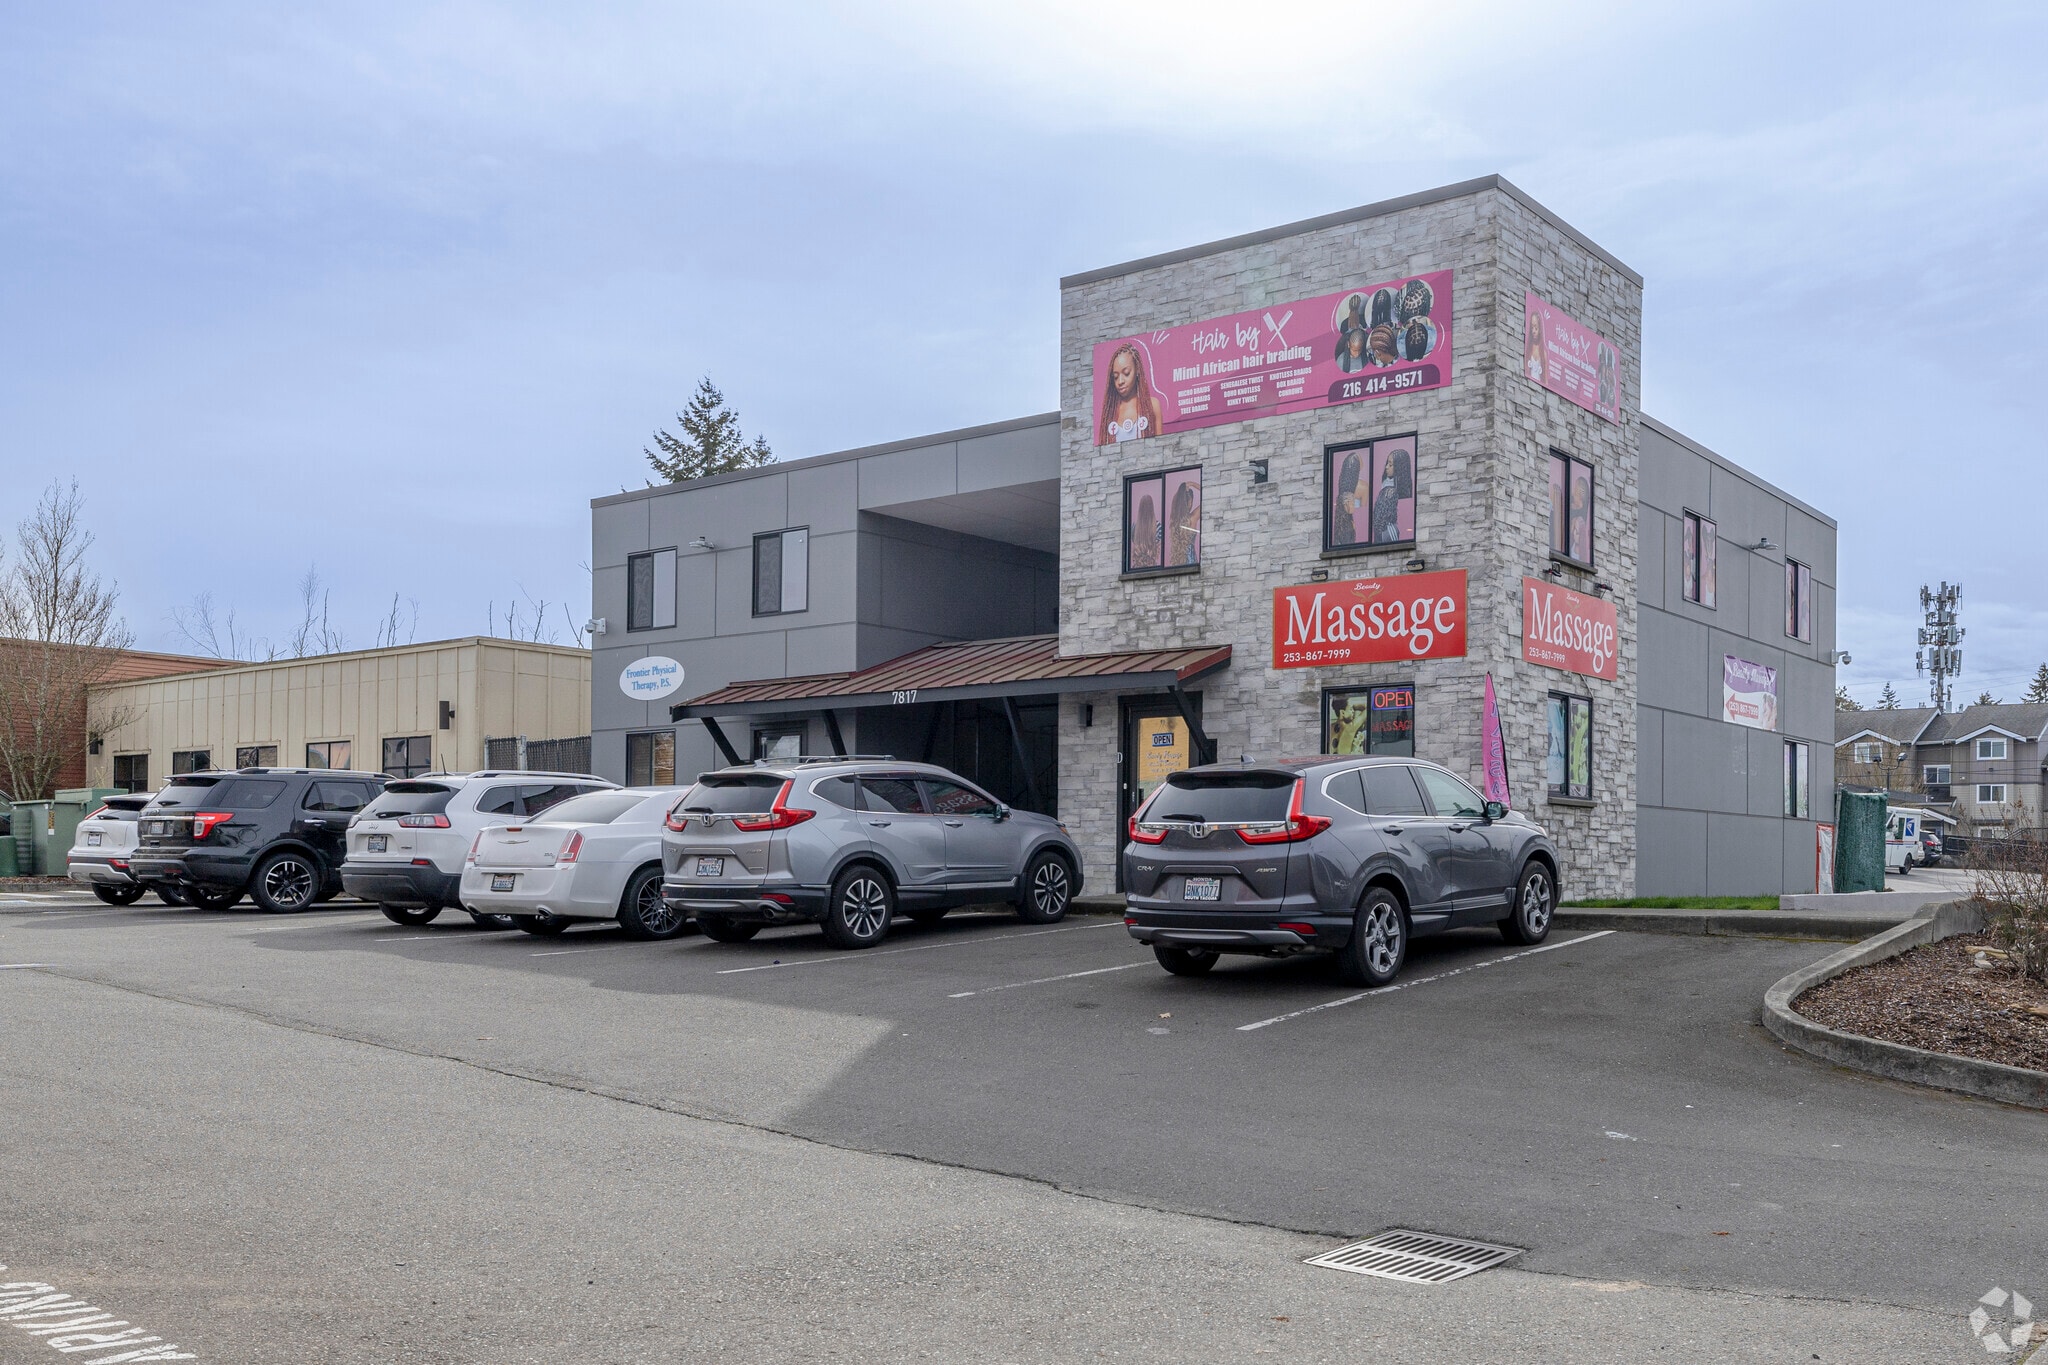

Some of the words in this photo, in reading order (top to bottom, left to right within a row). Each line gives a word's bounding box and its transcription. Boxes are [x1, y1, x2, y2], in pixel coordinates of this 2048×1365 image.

[1191, 328, 1230, 354] Hair
[1236, 322, 1261, 351] by
[1173, 364, 1200, 382] Mimi
[1203, 358, 1240, 377] African
[1242, 352, 1263, 369] hair
[1266, 345, 1312, 364] braiding
[1293, 366, 1312, 377] BRAIDS
[1248, 375, 1264, 385] TWIST
[1287, 377, 1305, 387] BRAIDS
[1342, 381, 1362, 398] 216
[1365, 370, 1422, 393] 414-9571
[1193, 386, 1211, 396] BRAIDS
[1193, 394, 1211, 404] BRAIDS
[1241, 394, 1258, 405] TWIST
[1192, 403, 1209, 413] BRAIDS
[1353, 582, 1381, 591] Beauty
[1284, 592, 1456, 655] Massage
[1529, 587, 1614, 673] Massage
[1283, 648, 1351, 663] 253-867-7999
[1528, 647, 1566, 663] 253-867-7999
[626, 667, 651, 678] Frontier
[652, 662, 677, 676] Physical
[631, 680, 660, 691] Therapy,
[892, 689, 917, 704] 7817
[1374, 691, 1413, 708] OPEN
[1153, 735, 1171, 744] OPEN
